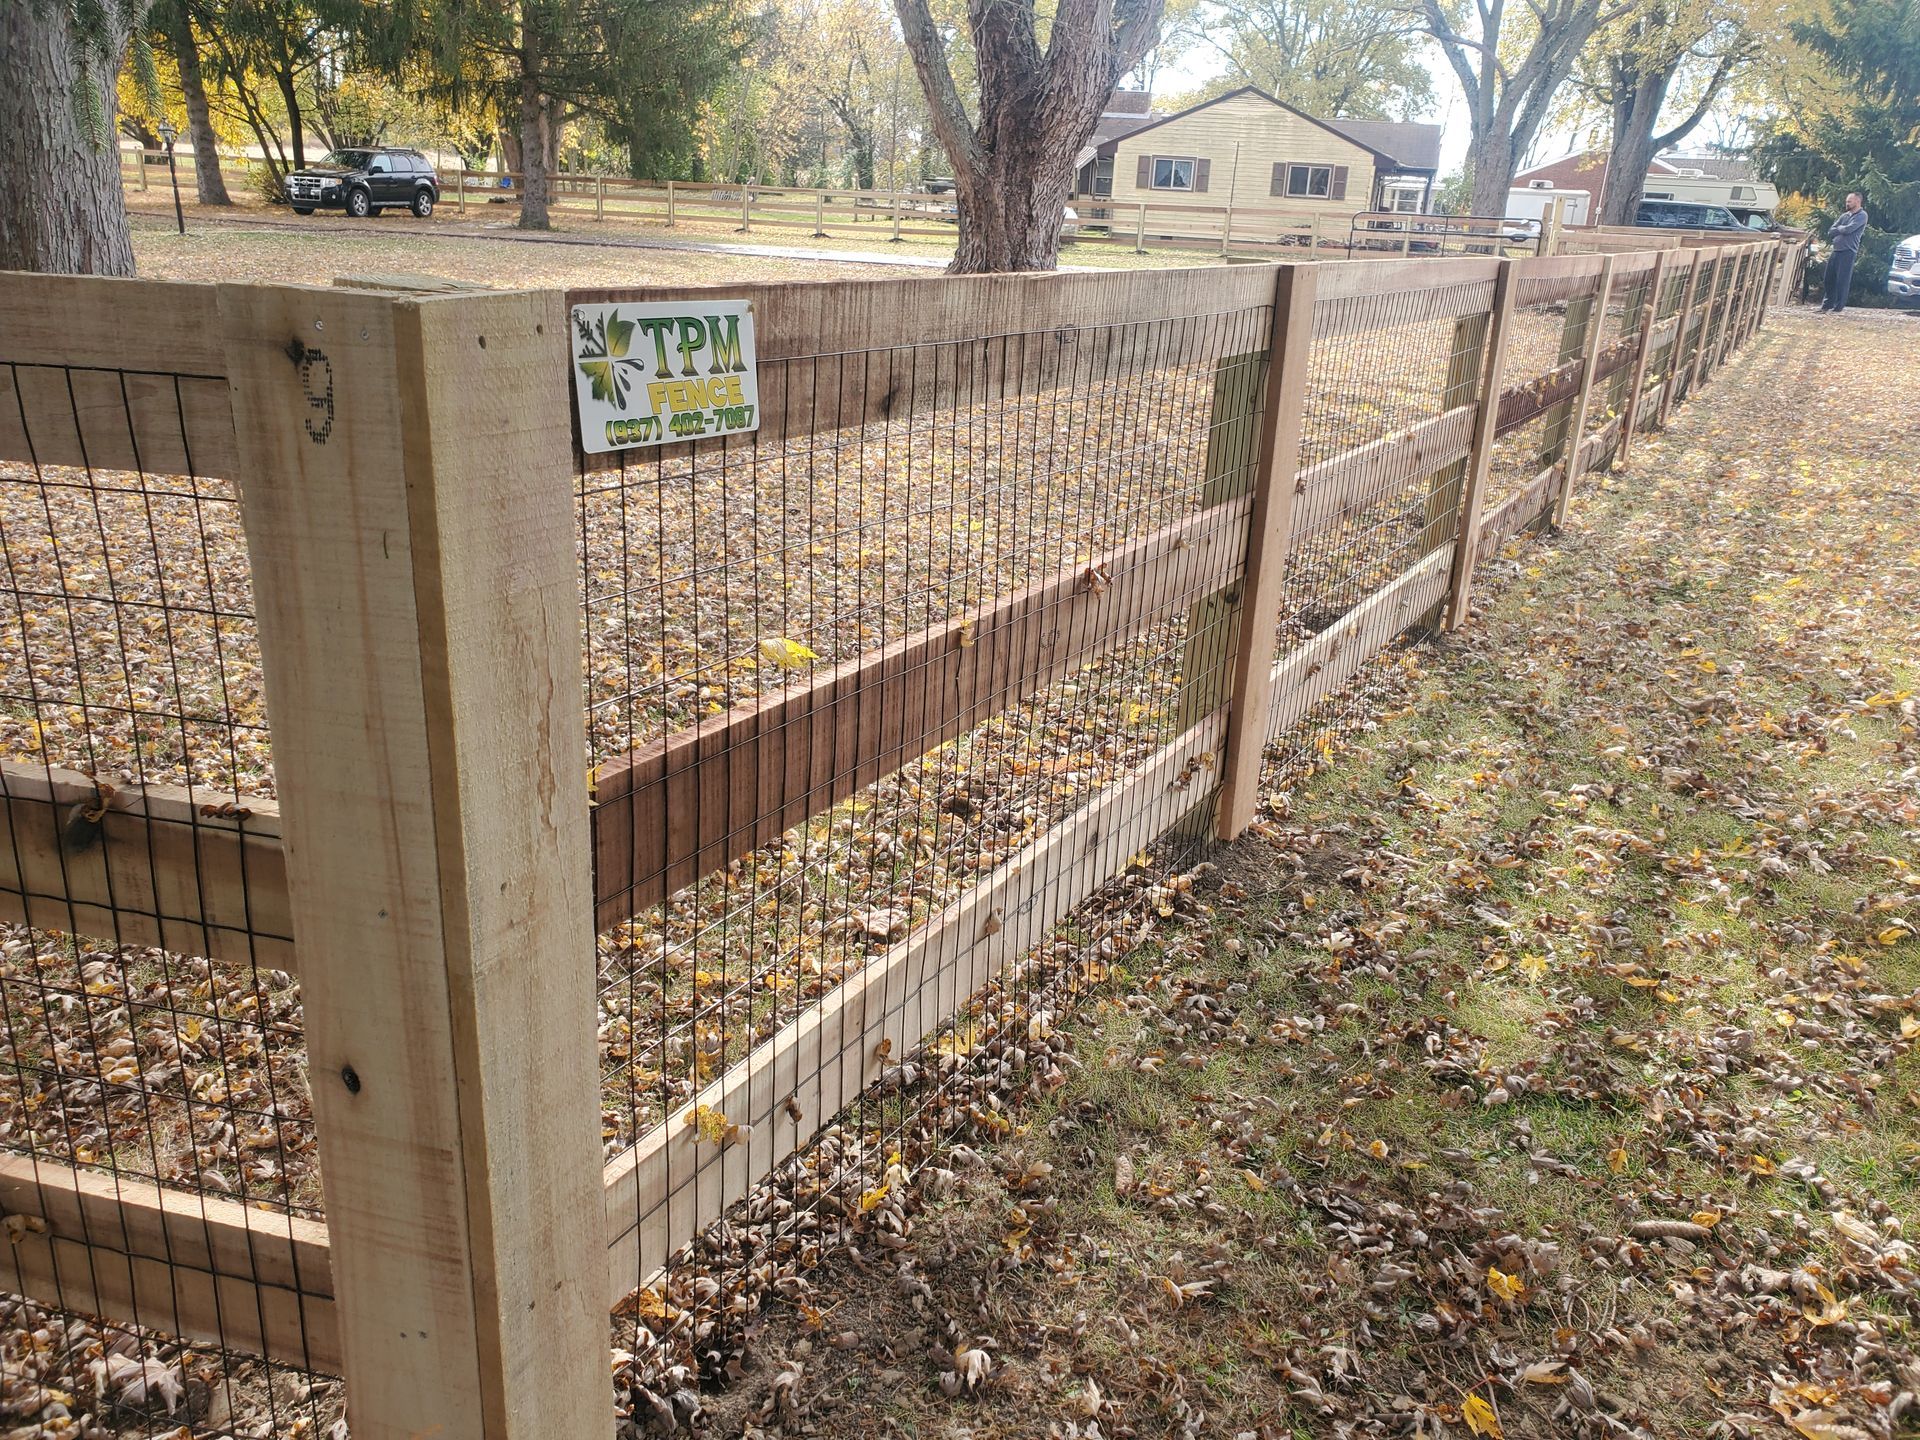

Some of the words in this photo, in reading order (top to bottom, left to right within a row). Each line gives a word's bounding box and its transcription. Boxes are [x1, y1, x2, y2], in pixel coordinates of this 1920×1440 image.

[637, 315, 748, 379] TPM
[647, 375, 745, 415] FENCE
[605, 416, 663, 447] (937)
[669, 405, 755, 437] 402-7087
